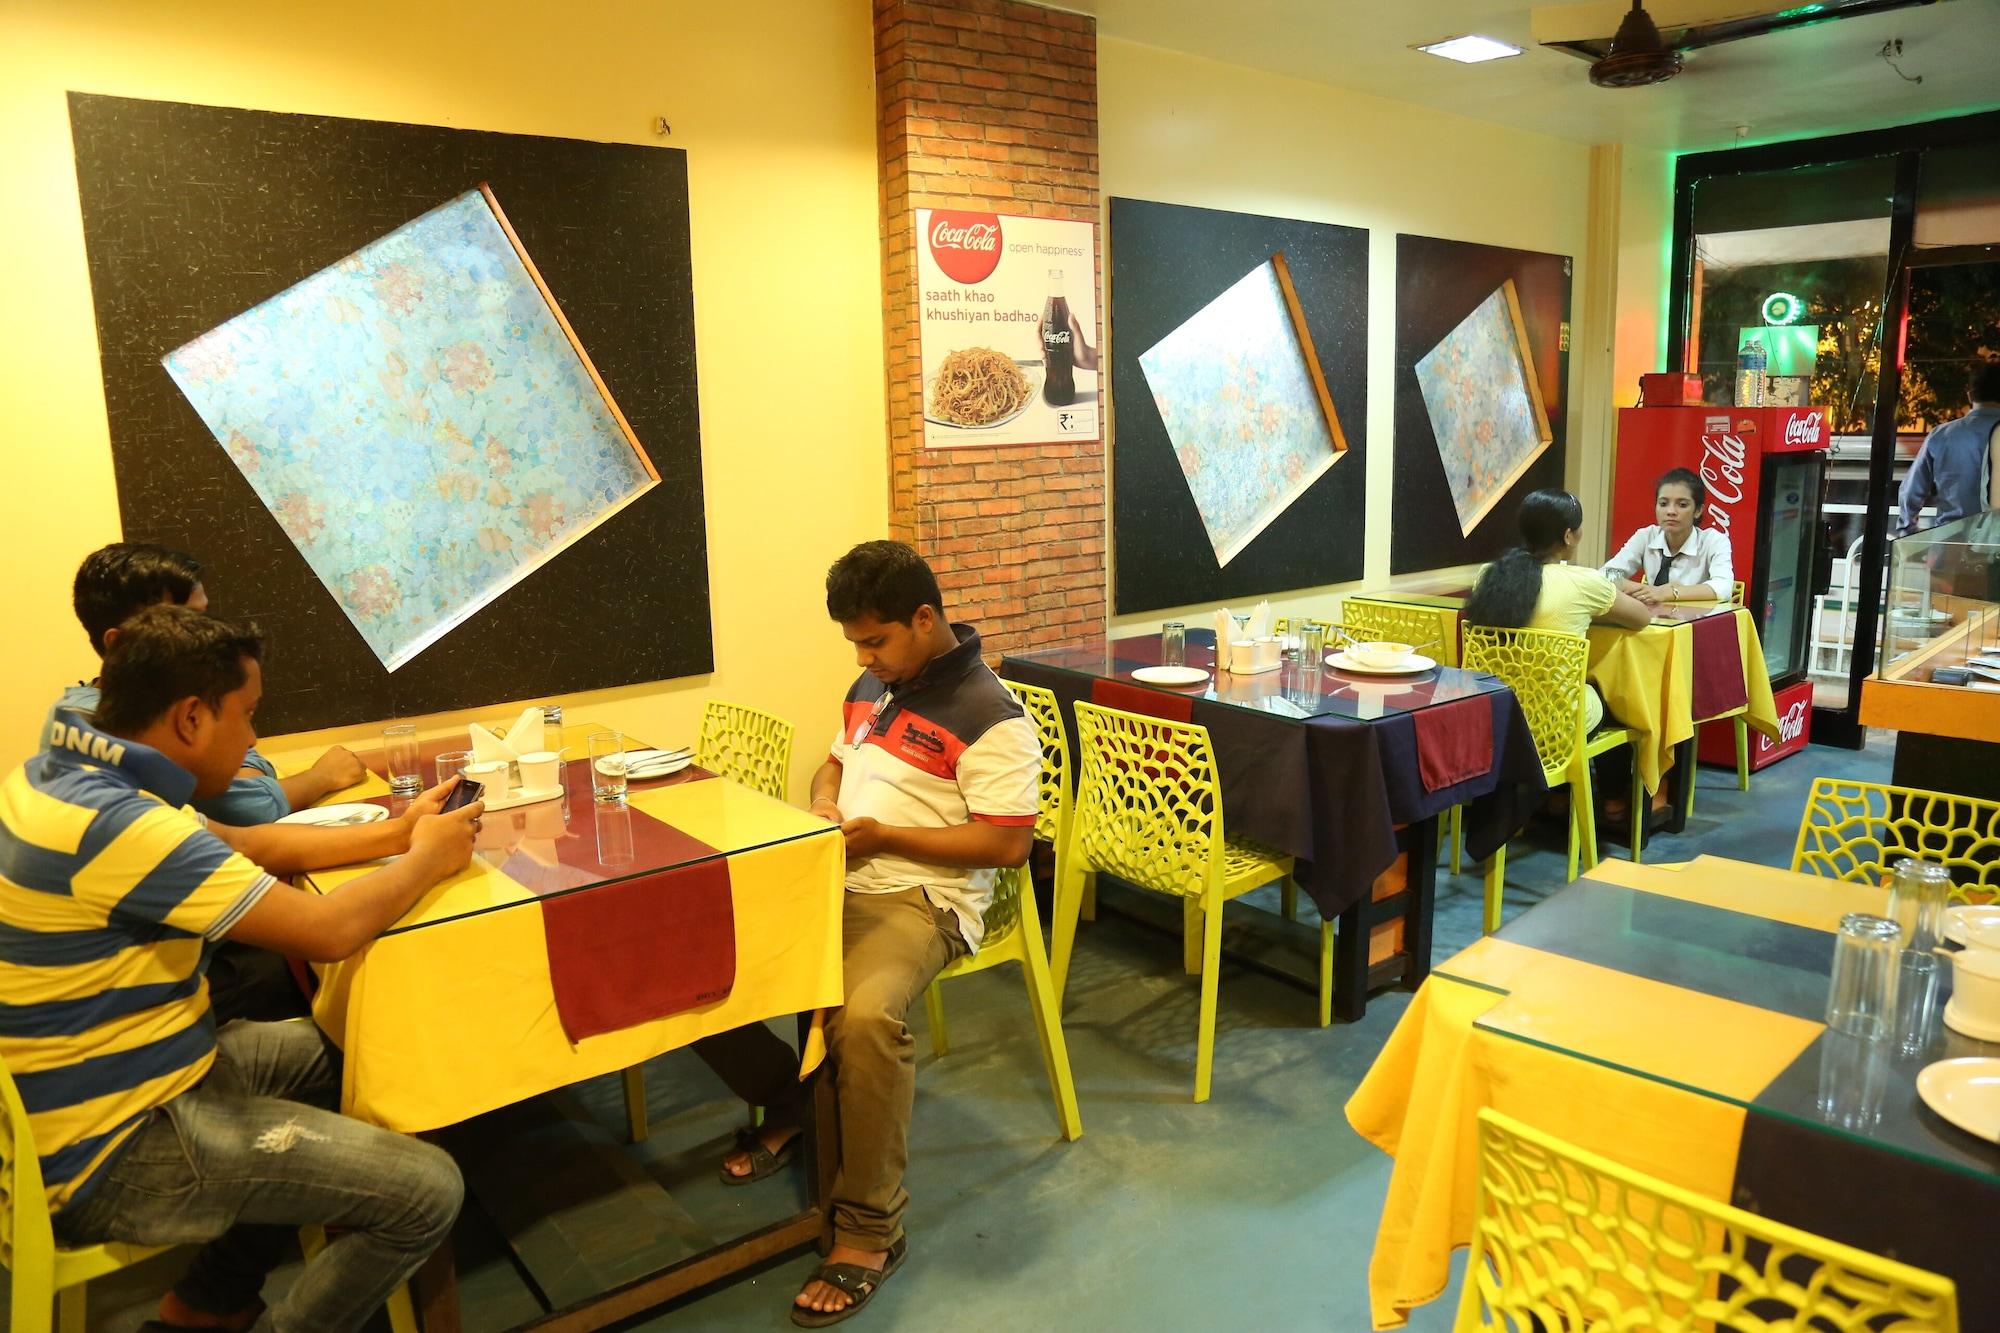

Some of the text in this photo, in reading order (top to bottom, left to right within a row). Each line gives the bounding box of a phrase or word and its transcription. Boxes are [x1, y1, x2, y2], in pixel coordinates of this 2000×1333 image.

[931, 220, 999, 251] Coca-Cola
[1008, 241, 1084, 257] open happiness
[925, 289, 995, 303] saath khao
[926, 307, 1039, 324] khushiyan badhao
[1785, 412, 1823, 445] Coca-Cola
[50, 721, 126, 767] DNM
